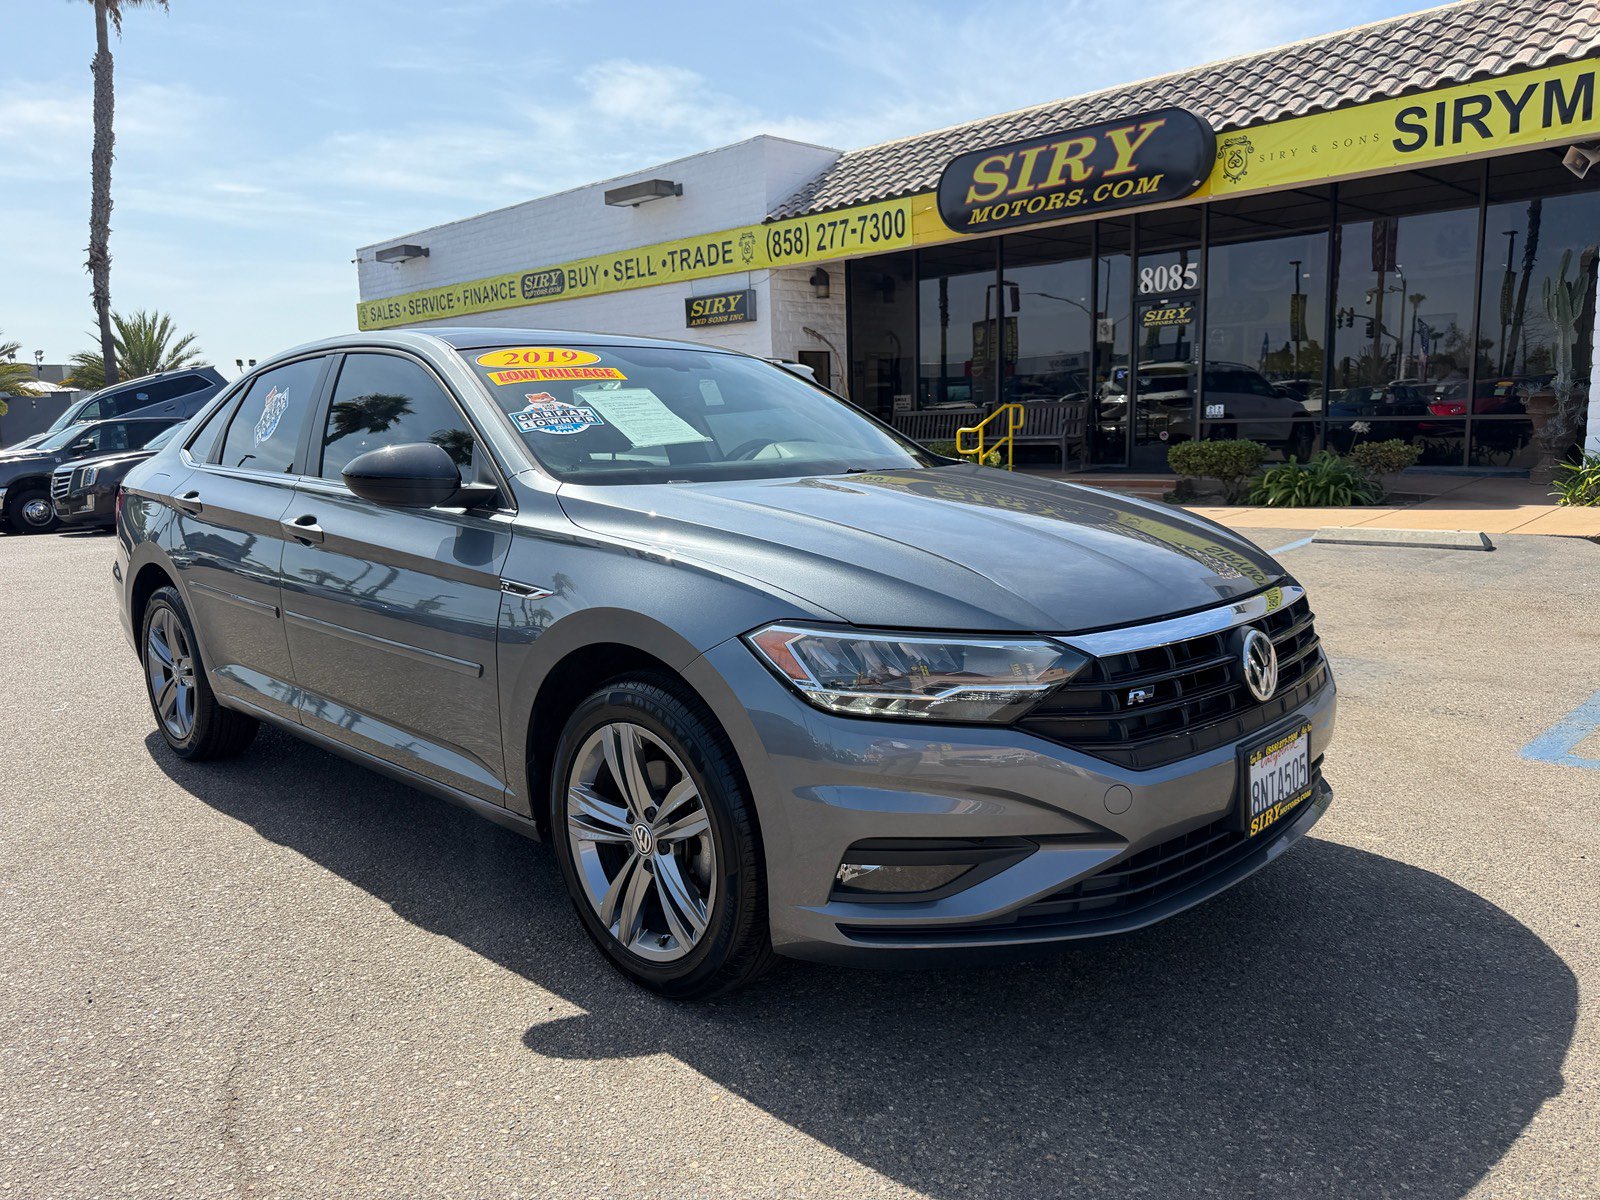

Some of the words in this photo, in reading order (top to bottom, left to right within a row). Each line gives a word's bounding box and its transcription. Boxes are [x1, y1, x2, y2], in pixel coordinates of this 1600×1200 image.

[1392, 72, 1595, 152] SIRYM
[965, 118, 1166, 204] SIRY
[1259, 148, 1298, 162] SIRY
[1311, 145, 1318, 153] &
[1332, 133, 1380, 150] SONS
[968, 174, 1164, 225] MOTORS.COM
[766, 222, 810, 262] (858)
[816, 208, 905, 252] 277-7300
[568, 265, 599, 289] BUY
[613, 256, 657, 281] SELL
[667, 240, 734, 273] TRADE
[1140, 263, 1198, 293] 8085
[524, 270, 562, 290] SIRY
[370, 302, 400, 322] SALES
[408, 292, 454, 315] SERVICE
[463, 280, 517, 306] FINANCE
[690, 294, 743, 317] SIRY
[1143, 307, 1192, 321] SIRY
[691, 318, 706, 326] AND
[708, 315, 728, 324] SONS
[730, 313, 744, 321] INC
[503, 351, 578, 365] 2019
[497, 369, 538, 382] LOW
[541, 368, 619, 379] MILEAGE
[517, 409, 590, 421] CARFAX
[536, 416, 595, 426] OWNER
[1251, 752, 1306, 816] 8NTA505
[1250, 801, 1283, 838] SIRY
